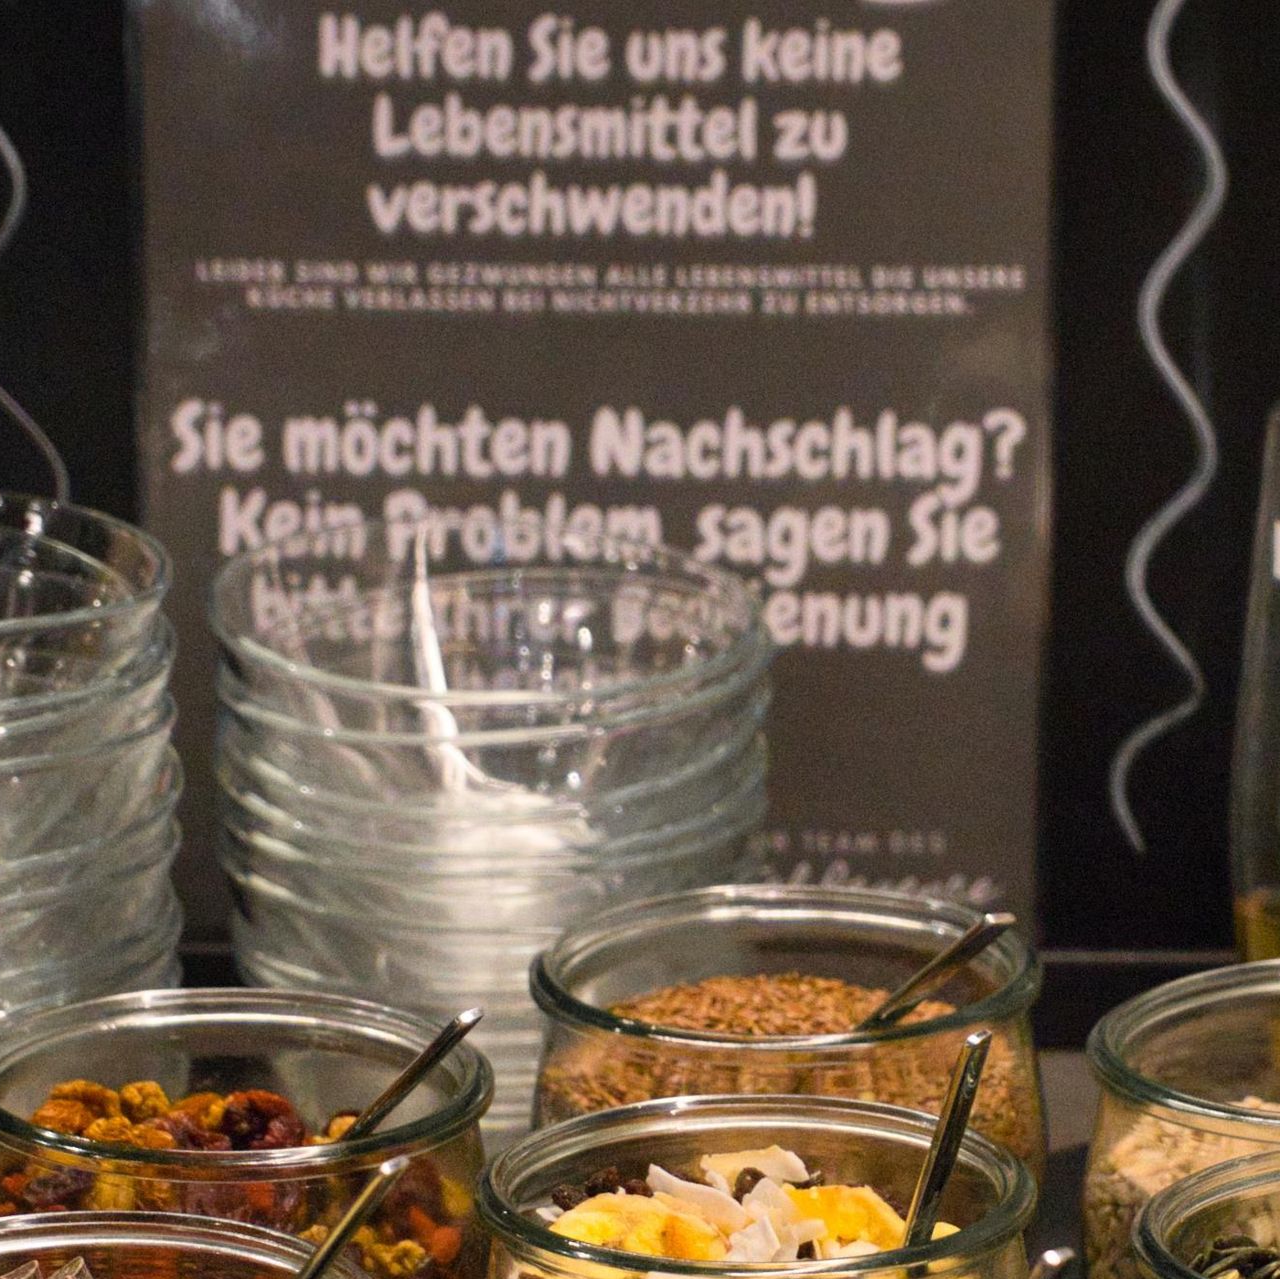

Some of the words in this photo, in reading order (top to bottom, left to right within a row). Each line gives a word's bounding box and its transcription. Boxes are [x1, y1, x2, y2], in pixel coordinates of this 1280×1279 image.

[320, 15, 512, 81] Helfen
[528, 17, 608, 82] Sie
[626, 31, 726, 82] uns
[742, 17, 903, 84] keine
[373, 93, 757, 160] Lebensmittel
[773, 110, 848, 162] zu
[366, 171, 816, 240] verschwenden!
[171, 402, 265, 474] Sie
[282, 403, 571, 478] möchten
[591, 408, 1028, 507] Nachschlag?
[219, 488, 366, 557] Kein
[694, 504, 889, 588] sagen
[909, 498, 1000, 567] Sie
[612, 582, 966, 673] Bedenung
